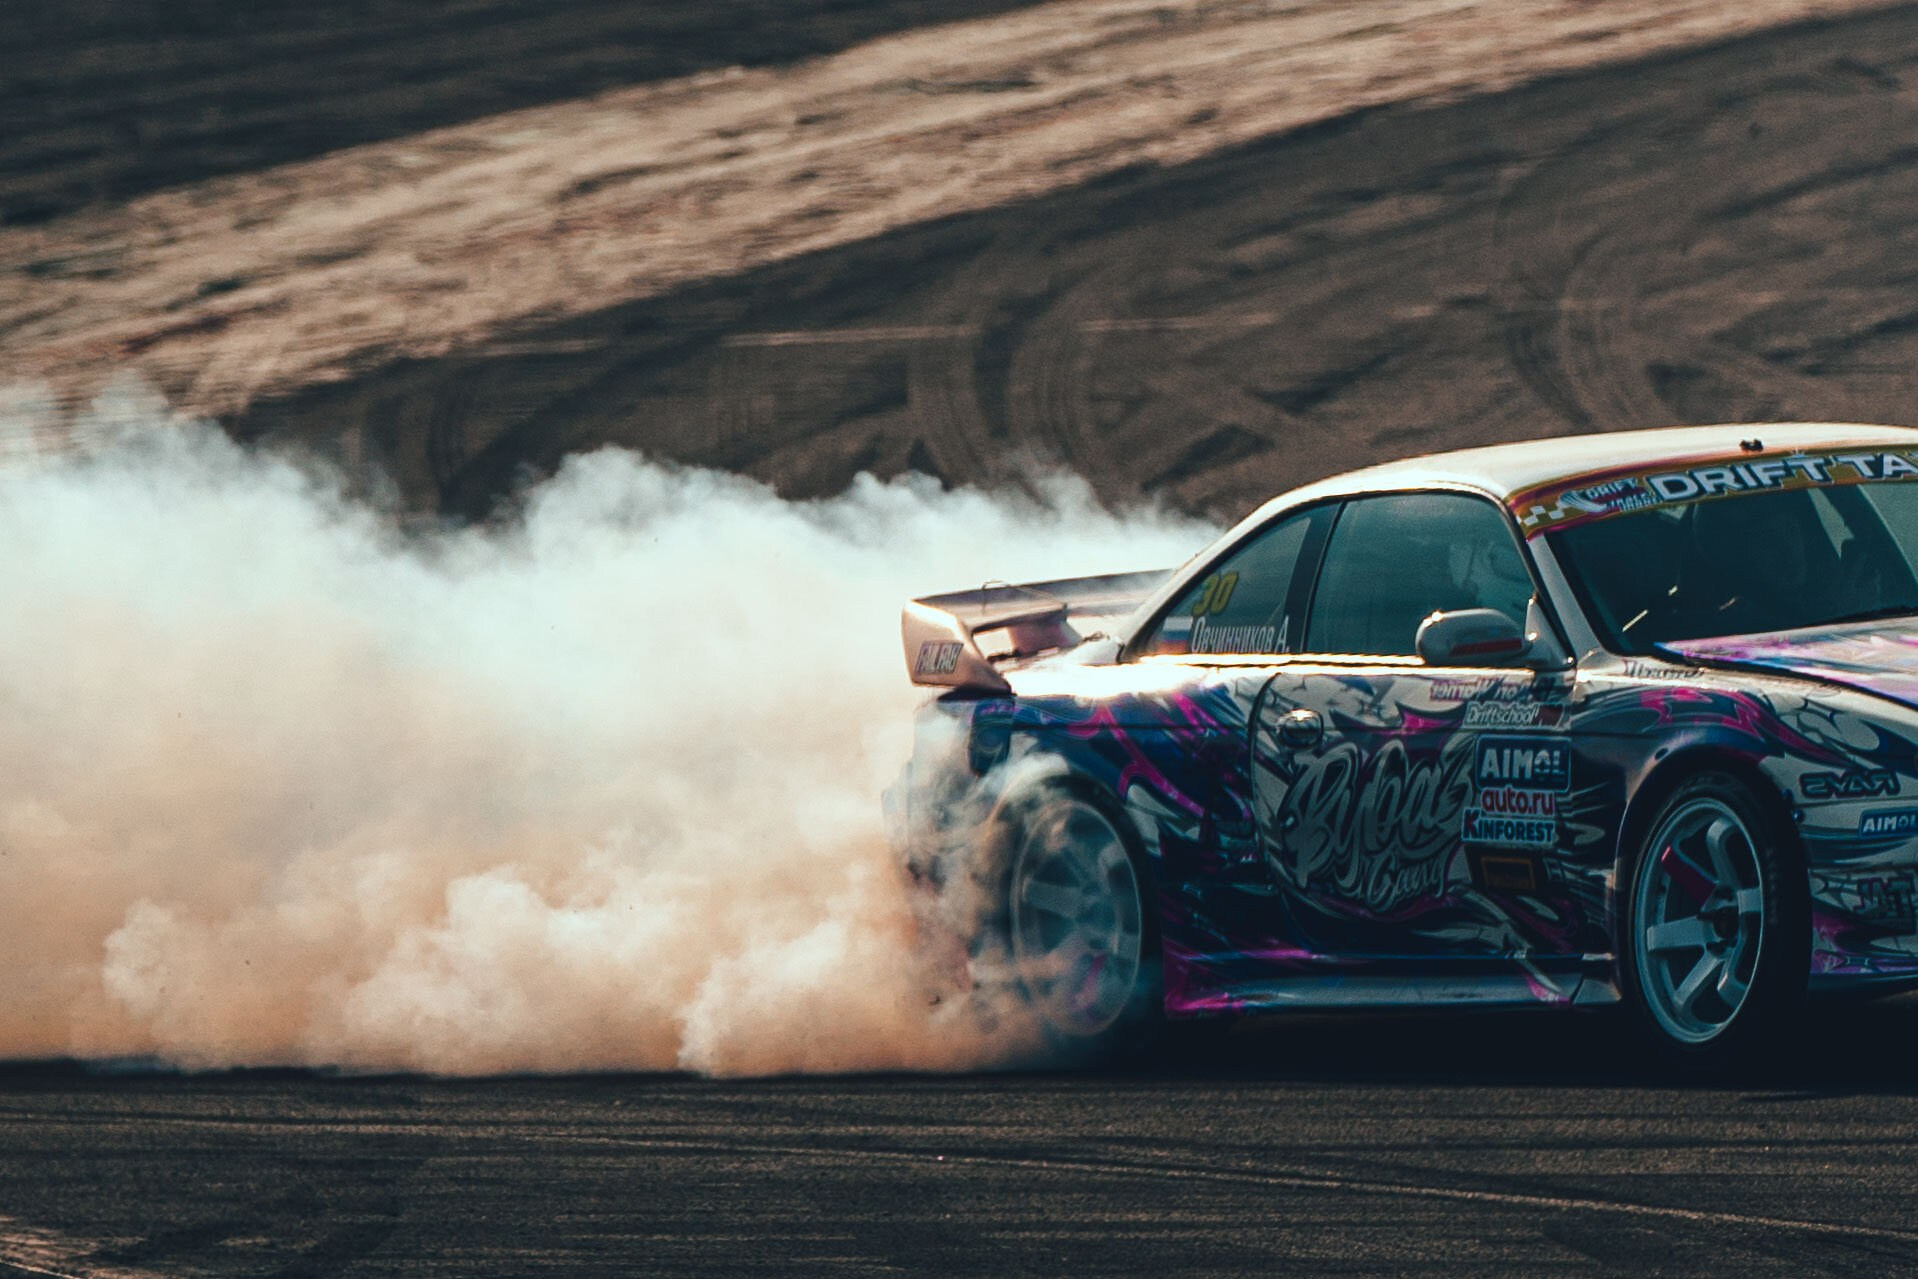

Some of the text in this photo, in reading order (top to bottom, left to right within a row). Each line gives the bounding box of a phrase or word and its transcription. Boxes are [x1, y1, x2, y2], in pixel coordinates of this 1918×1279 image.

[1650, 454, 1918, 499] DRIFT TA
[1191, 571, 1239, 617] 30
[1191, 616, 1275, 653] Овчинников
[1466, 702, 1539, 724] Driftschool
[1481, 748, 1565, 780] AIMOL
[1481, 785, 1555, 816] auto.ru
[1462, 809, 1554, 841] KINFOREST
